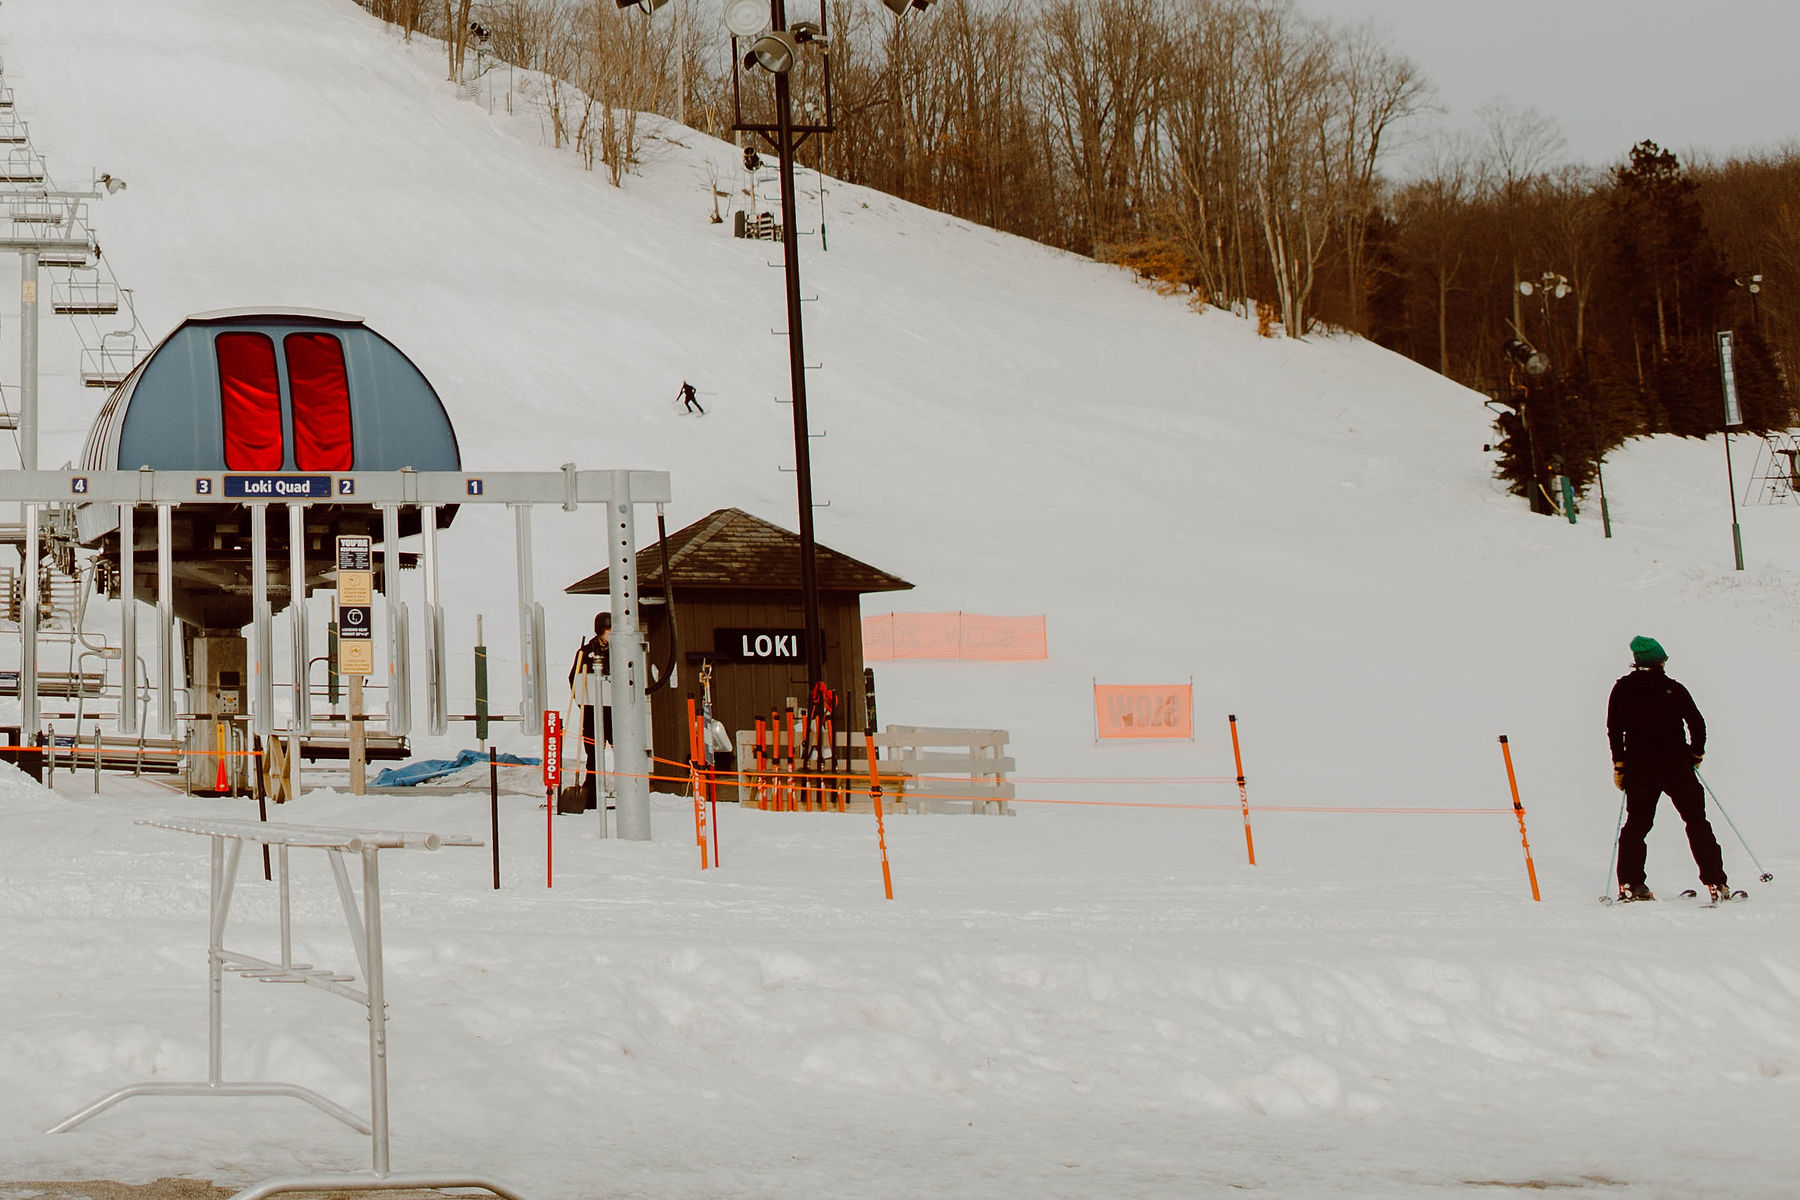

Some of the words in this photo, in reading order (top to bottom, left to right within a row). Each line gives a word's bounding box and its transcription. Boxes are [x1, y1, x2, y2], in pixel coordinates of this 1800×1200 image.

[74, 479, 85, 492] 4
[199, 480, 208, 493] 3
[244, 480, 272, 493] Loki
[275, 480, 311, 495] Quad
[342, 481, 351, 493] 2
[471, 481, 478, 494] 1
[742, 634, 797, 657] LOKI
[547, 712, 556, 734] SKI
[547, 736, 557, 779] SCHOOL
